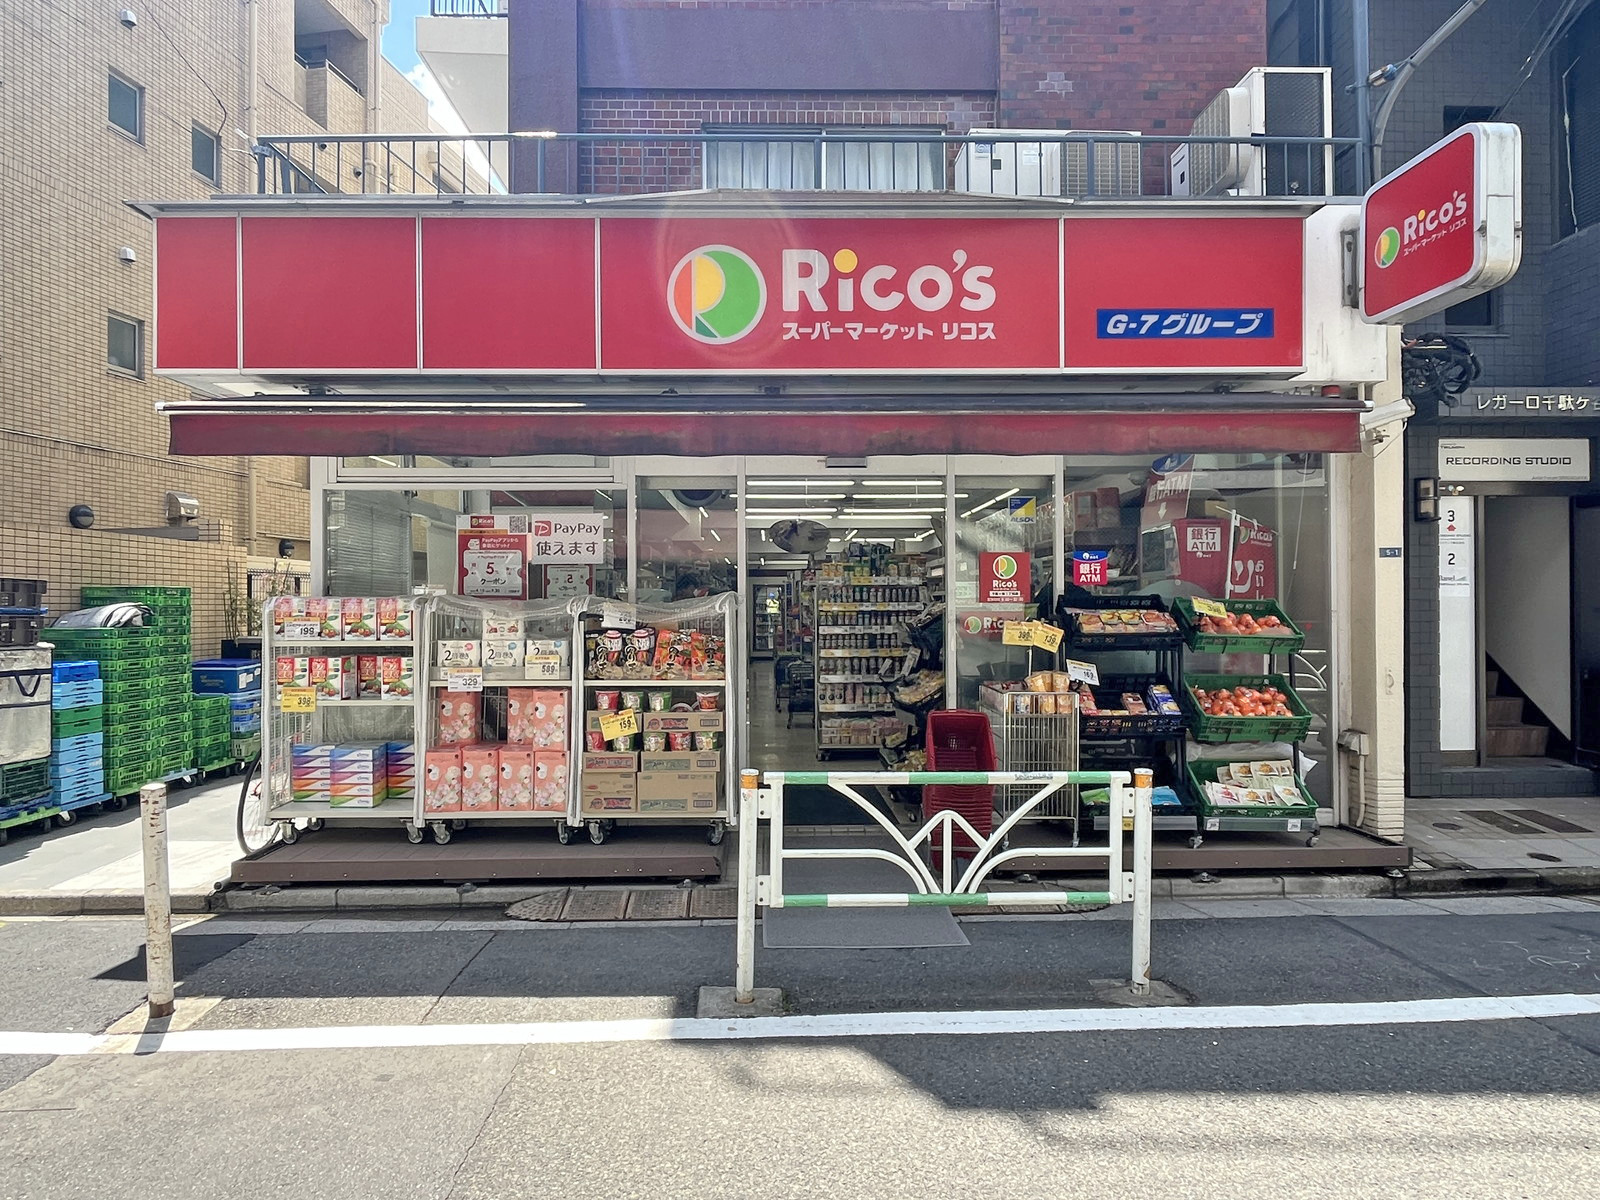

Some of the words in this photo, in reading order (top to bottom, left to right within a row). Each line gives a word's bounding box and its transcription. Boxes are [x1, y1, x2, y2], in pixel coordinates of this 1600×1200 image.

[1403, 190, 1467, 245] Rico's
[782, 248, 997, 313] Rico's
[782, 322, 934, 341] スーパーマーケット
[943, 322, 997, 341] リコス
[1445, 456, 1522, 466] RECORDING
[1525, 456, 1572, 466] STUDIO
[1447, 509, 1455, 523] 3
[554, 522, 600, 536] PayPay
[1191, 528, 1217, 540] 銀行
[536, 541, 599, 556] 使えます
[1191, 541, 1216, 550] ATM
[1447, 552, 1456, 566] 2
[1079, 562, 1102, 574] 銀行
[992, 579, 1018, 588] Rico's
[1079, 574, 1101, 583] ATM
[462, 678, 478, 686] 329
